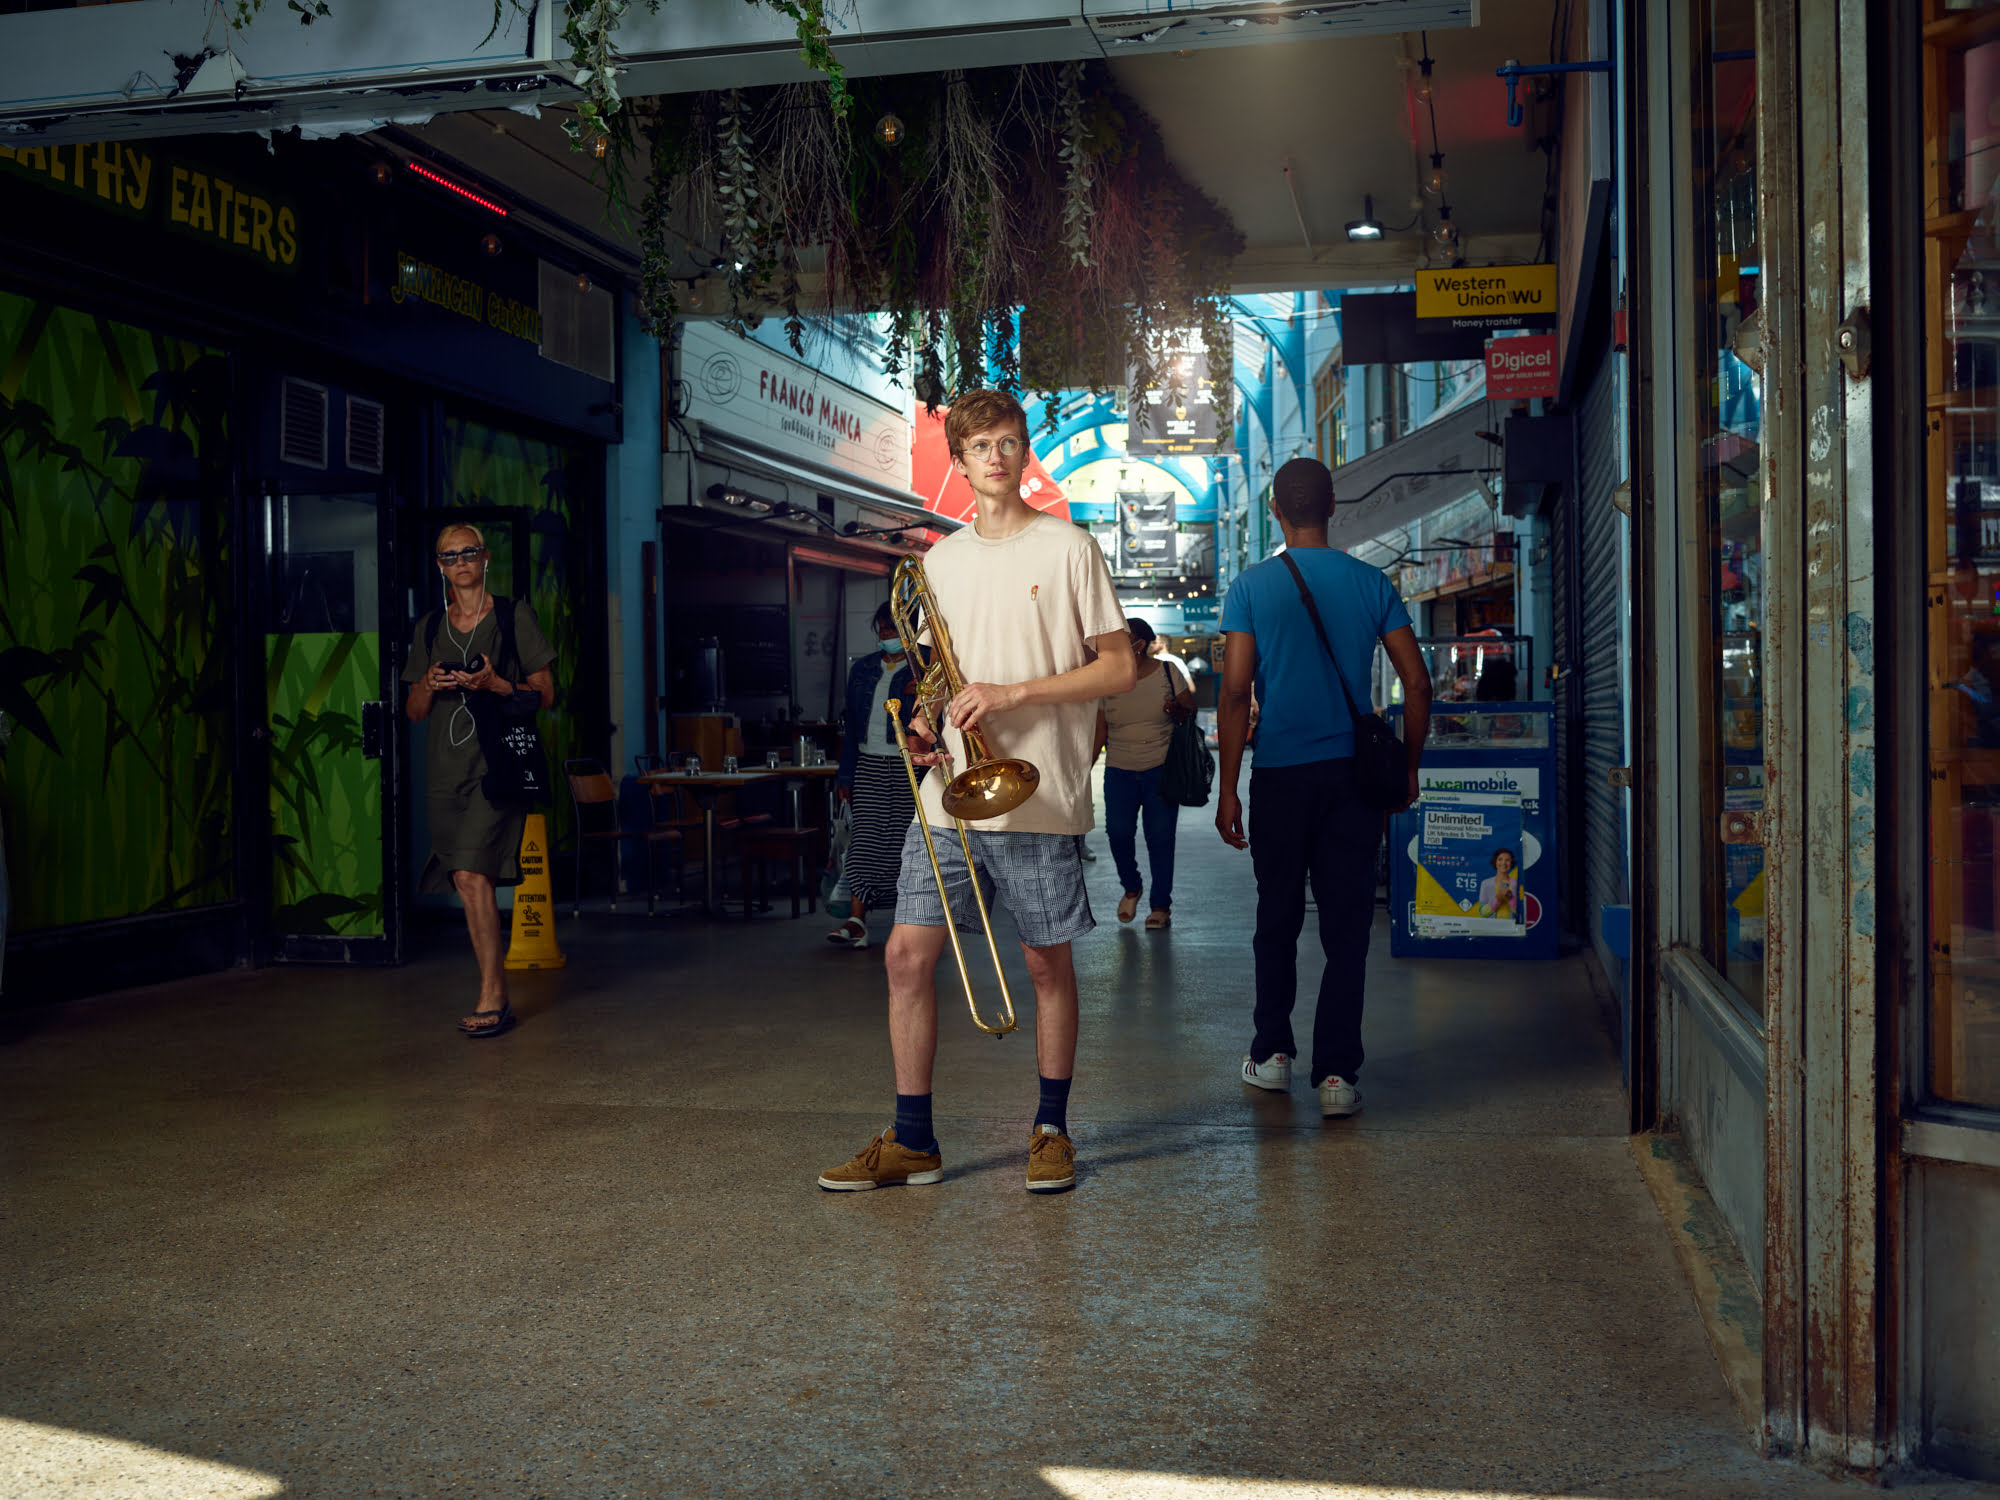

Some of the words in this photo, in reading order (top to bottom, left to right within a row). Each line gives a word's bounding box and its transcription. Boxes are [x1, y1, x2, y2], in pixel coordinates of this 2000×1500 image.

[170, 165, 297, 264] EATERS
[391, 250, 483, 323] JAMAICAN
[1433, 277, 1505, 291] Western
[1457, 291, 1506, 307] Union
[1452, 318, 1484, 328] Money
[1485, 317, 1523, 327] transfer
[1491, 350, 1551, 371] Digicel
[760, 370, 814, 417] FRANCO
[819, 395, 862, 442] MANCA
[818, 432, 836, 449] PIZZA
[1426, 777, 1518, 790] Lycamobile
[1425, 794, 1461, 802] Lycamobile
[1428, 813, 1482, 825] Unlimited
[1427, 824, 1464, 832] International
[522, 856, 543, 864] CAUTION
[1456, 877, 1477, 889] £15
[518, 894, 547, 903] ATTENTION
